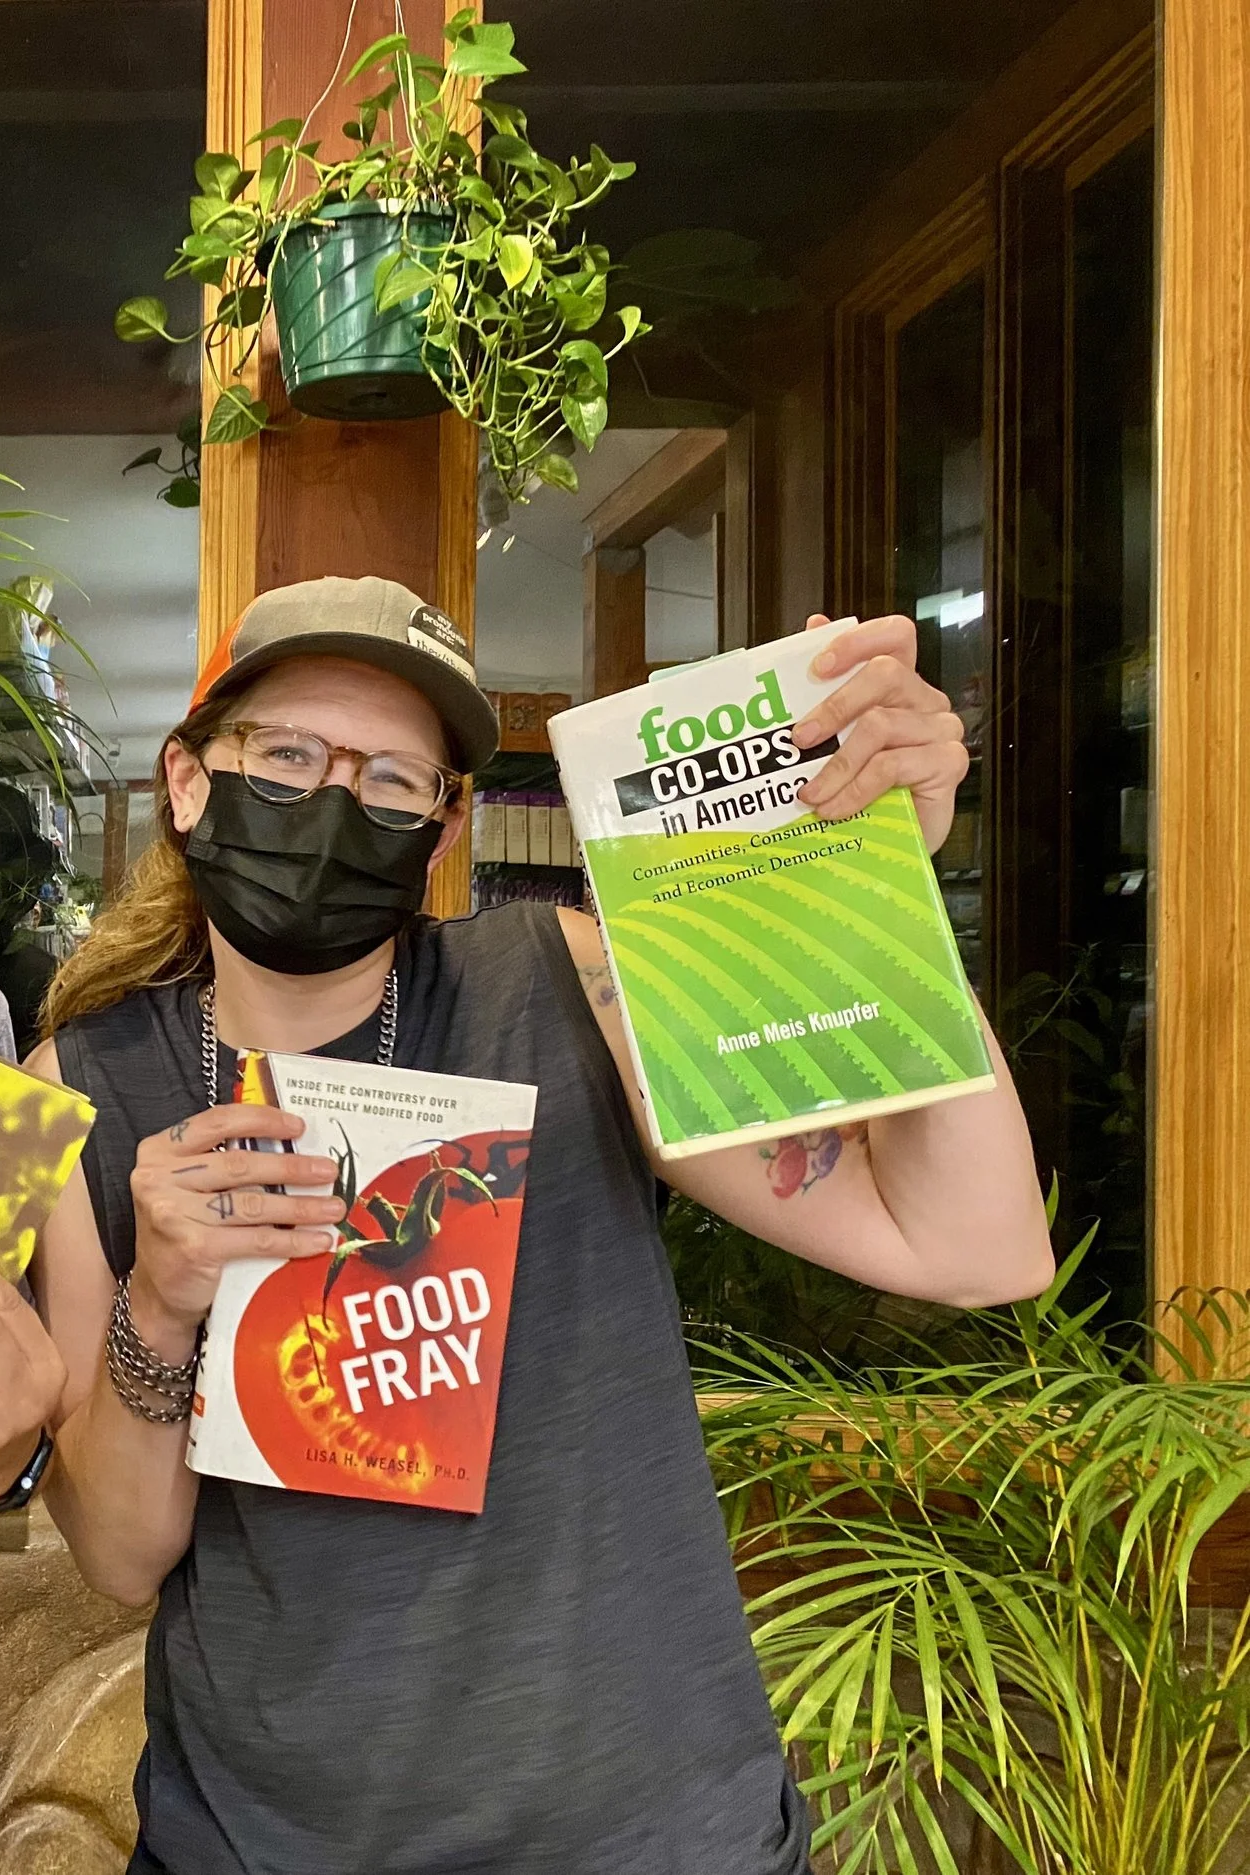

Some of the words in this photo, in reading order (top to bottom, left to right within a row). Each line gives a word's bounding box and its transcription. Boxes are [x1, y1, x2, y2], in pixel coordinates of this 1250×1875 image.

[422, 612, 467, 647] pronouns
[637, 669, 793, 766] food
[649, 728, 802, 803] CO-OPS
[659, 810, 688, 839] in
[632, 843, 747, 881] Communities,
[653, 883, 682, 904] and
[686, 863, 767, 894] Economic
[768, 837, 863, 872] Democracy
[715, 1029, 760, 1057] Anne
[763, 1017, 807, 1048] Meis
[809, 1001, 881, 1037] Knupfer
[286, 1077, 321, 1092] INSIDE
[326, 1083, 346, 1095] THE
[349, 1086, 426, 1105] CONTROVERSY
[429, 1096, 457, 1110] OVER
[289, 1094, 358, 1113] GENETICALLY
[363, 1103, 412, 1120] MODIFIED
[416, 1111, 443, 1124] FOOD
[342, 1266, 492, 1351] FOOD
[339, 1328, 482, 1415] FRAY
[306, 1447, 337, 1465] LISA
[344, 1453, 358, 1467] H.
[365, 1456, 427, 1477] WEASEL,
